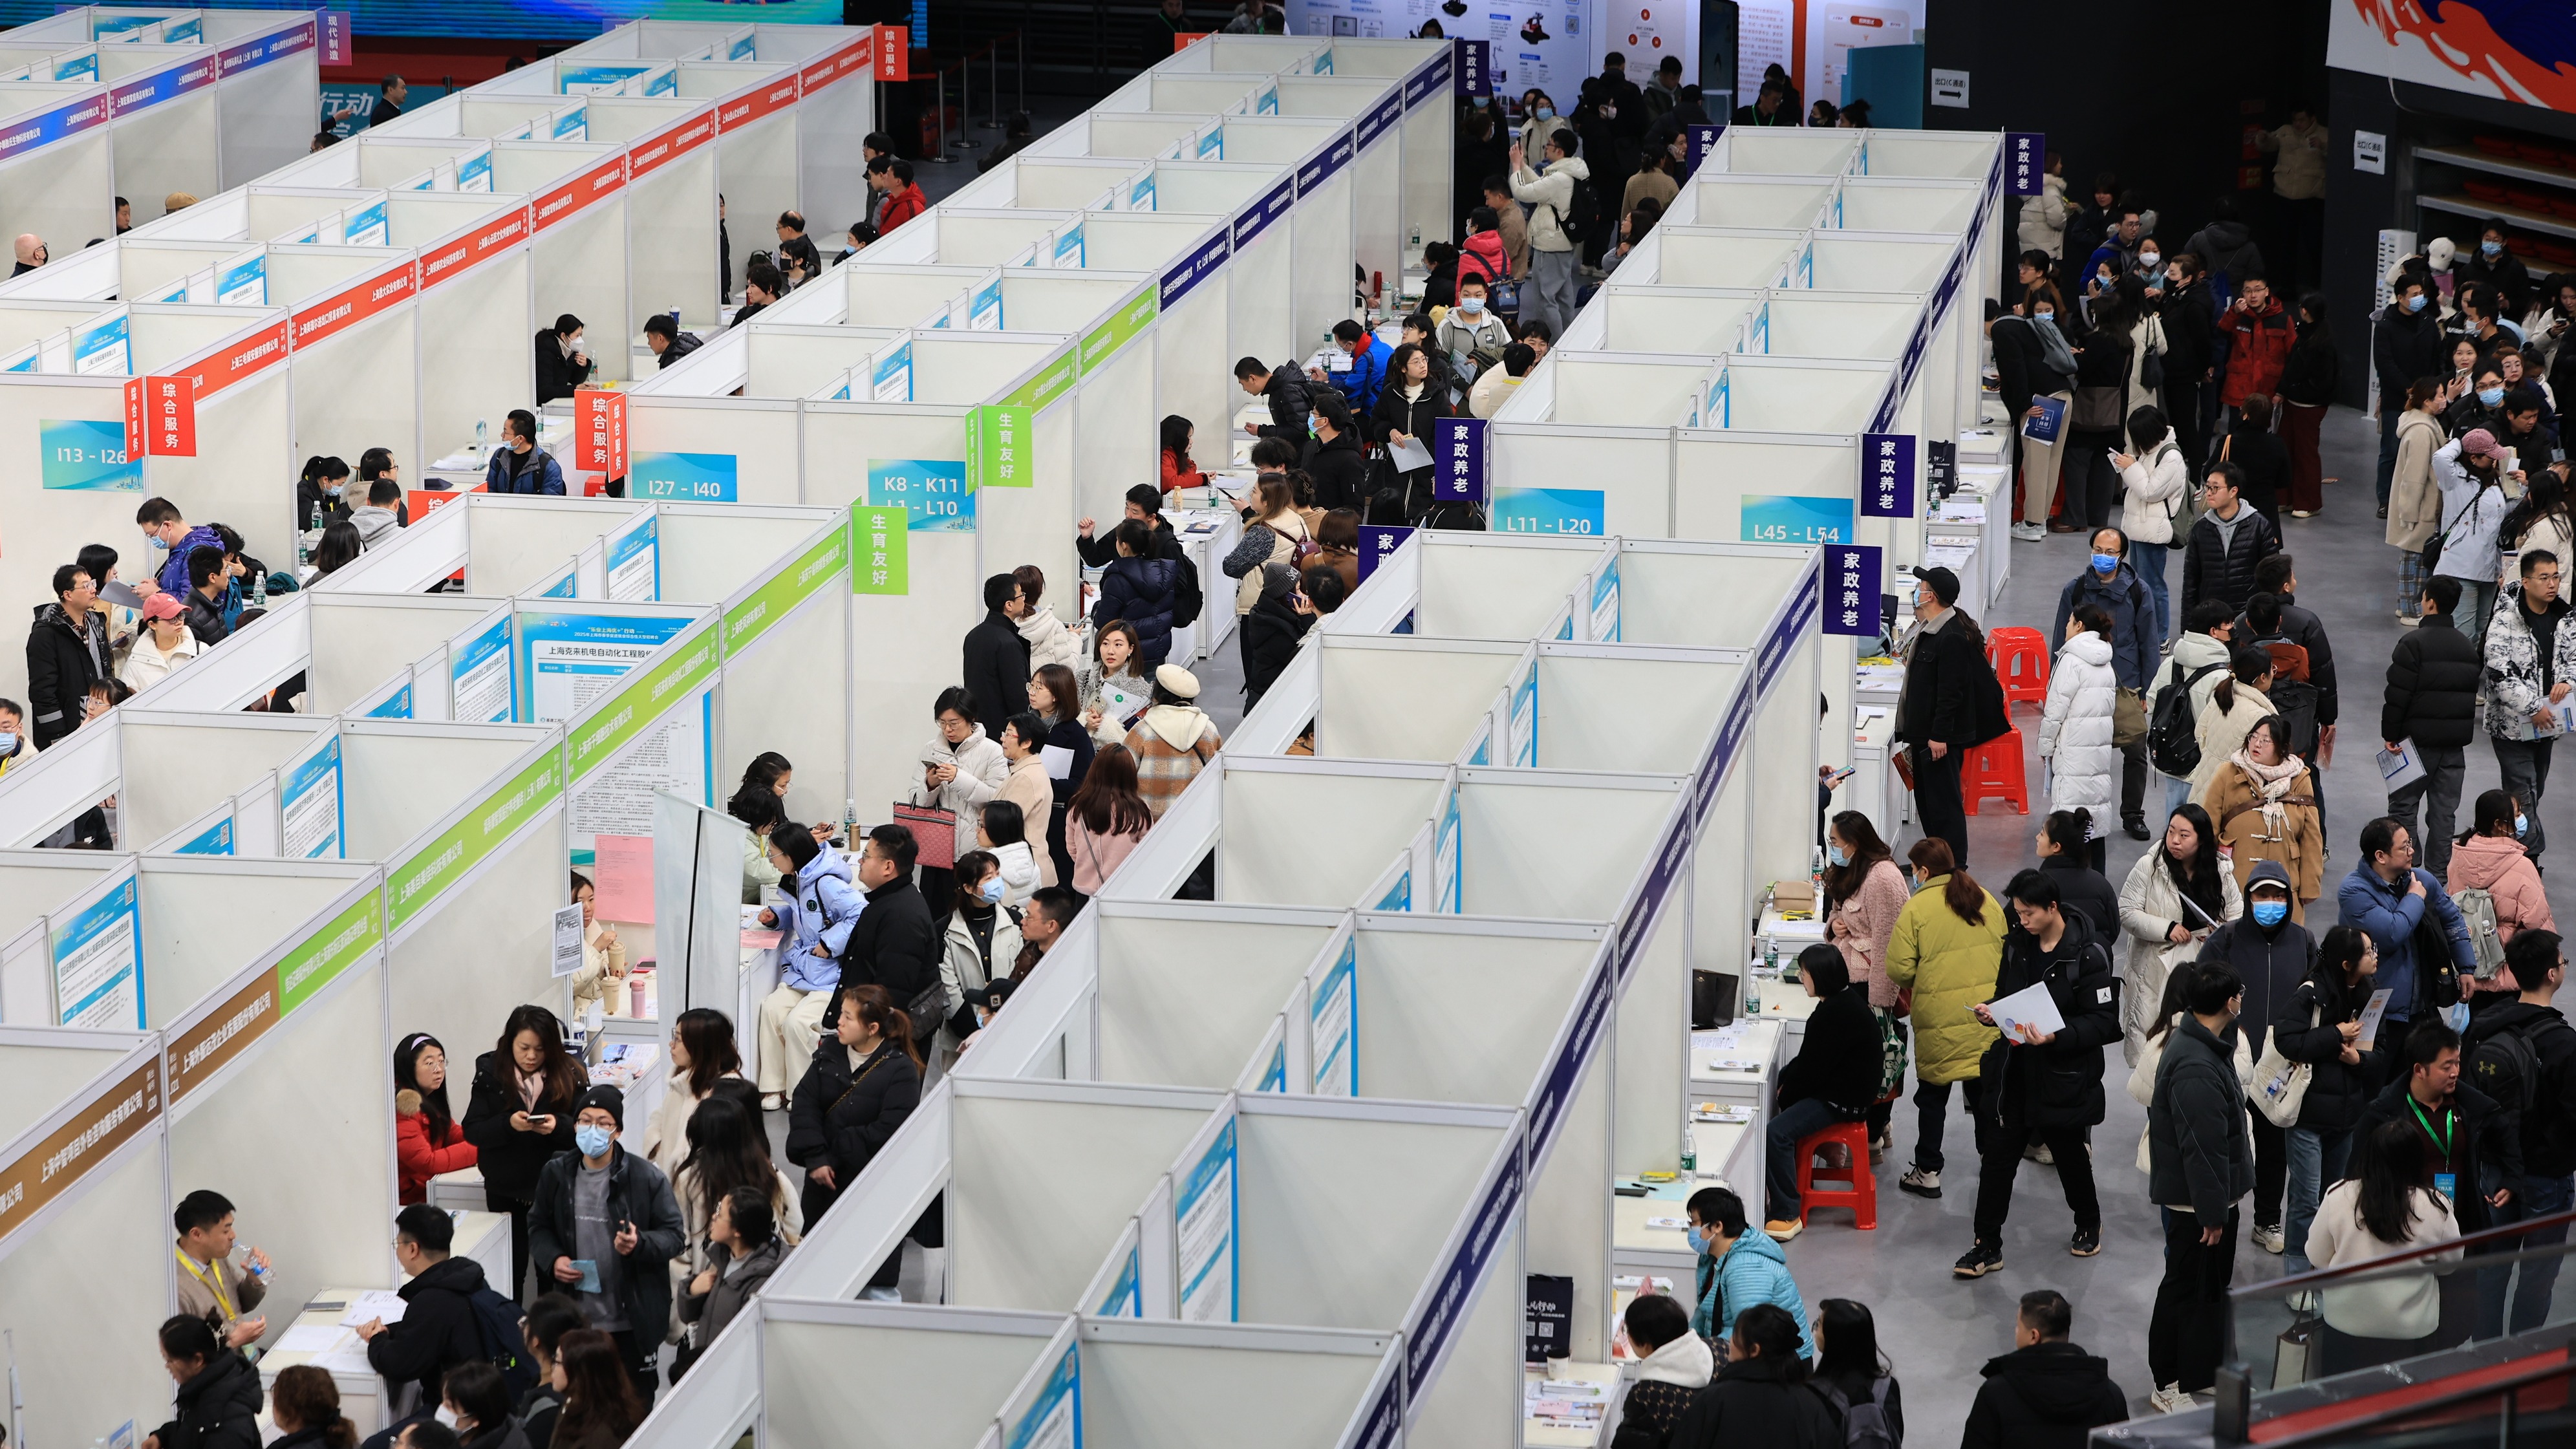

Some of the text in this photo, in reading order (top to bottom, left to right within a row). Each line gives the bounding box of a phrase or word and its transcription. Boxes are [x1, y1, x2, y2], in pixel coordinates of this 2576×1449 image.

[328, 16, 338, 59] 现代制造
[885, 31, 895, 75] 综合服务
[1466, 45, 1476, 90] 家政养老
[321, 91, 373, 118] 行动
[2017, 138, 2029, 189] 家政养老
[231, 337, 278, 372] 上海三毛保安服务有限公司
[163, 383, 178, 447] 综合服务
[593, 398, 607, 463] 综合服务
[58, 448, 83, 462] I13
[102, 448, 125, 464] I26
[999, 413, 1014, 478] 生育友好
[1454, 425, 1468, 492] 家政养老
[649, 481, 674, 496] I27
[694, 482, 720, 497] I40
[885, 477, 907, 491] K8
[927, 478, 956, 492] K11
[1879, 441, 1895, 508] 家政养老
[927, 500, 957, 515] L10
[1506, 517, 1539, 531] L11
[1558, 519, 1591, 534] L20
[872, 514, 887, 585] 生育友好
[1754, 526, 1787, 540] L45
[1807, 527, 1840, 542] L54
[1842, 553, 1860, 626] 家政养老
[731, 599, 765, 640] 上海老凤祥有限公司
[548, 647, 652, 658] 上海克来机电自动化工程股份
